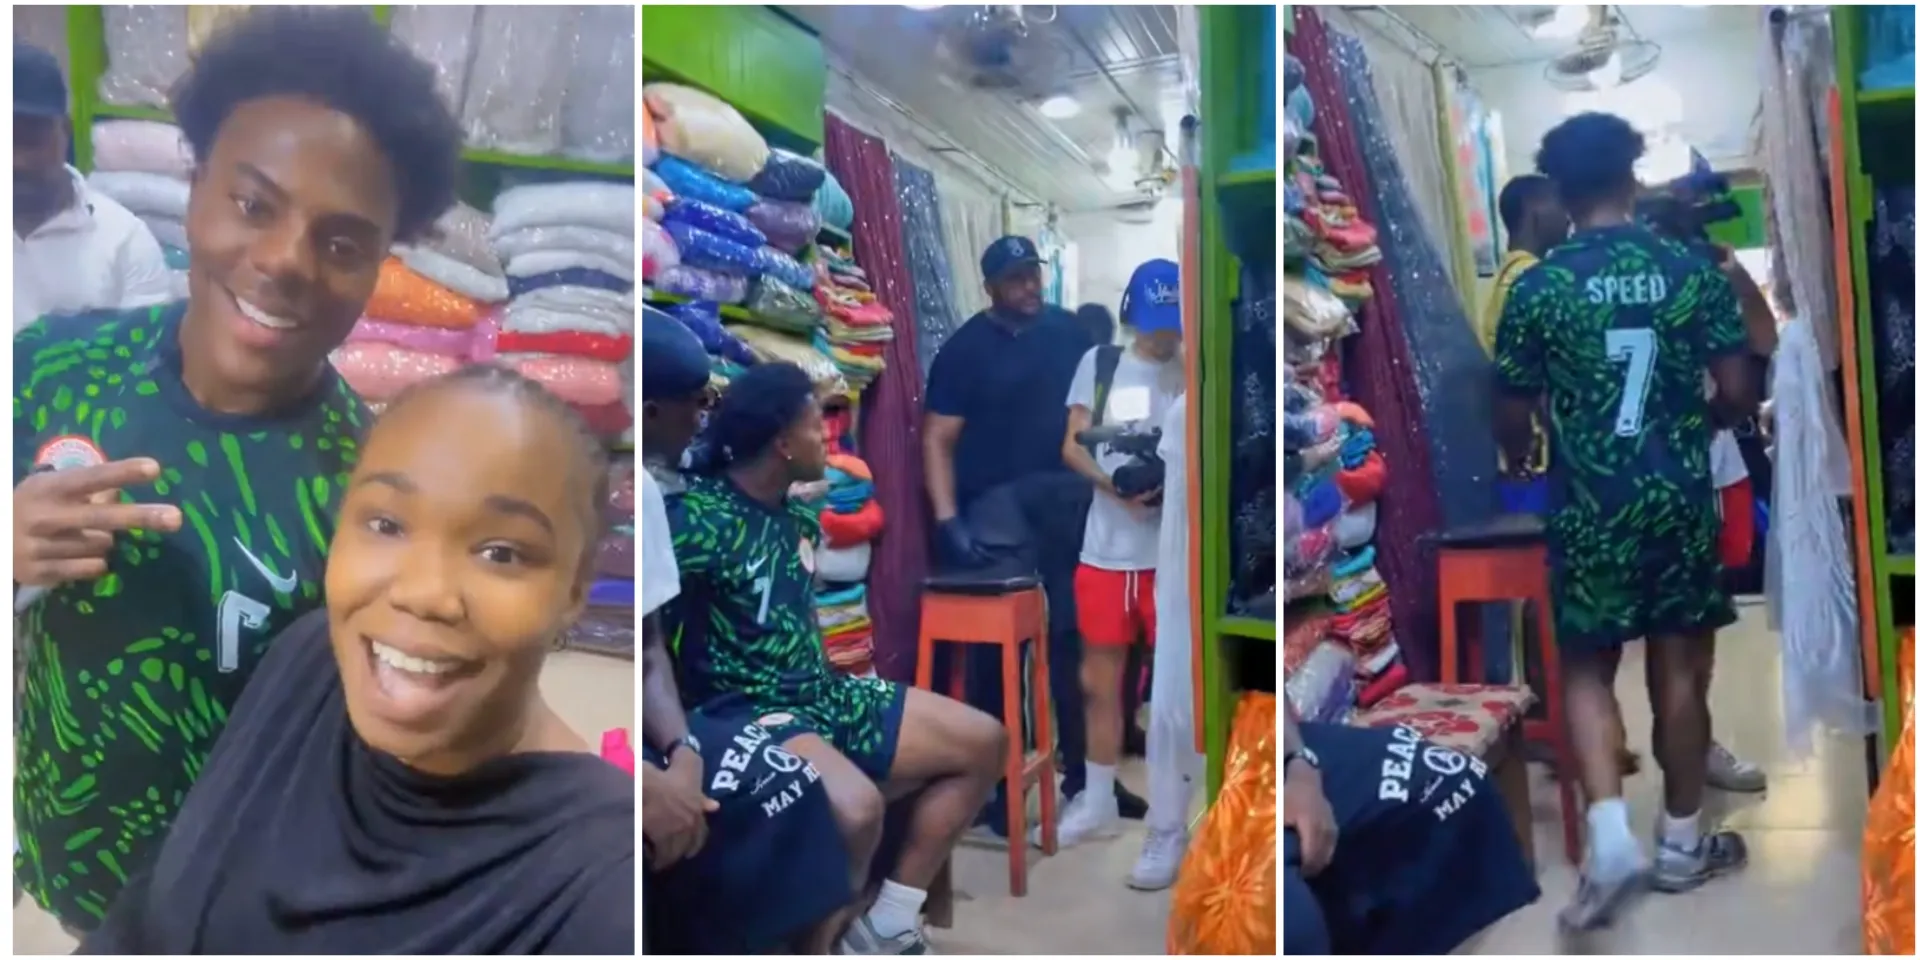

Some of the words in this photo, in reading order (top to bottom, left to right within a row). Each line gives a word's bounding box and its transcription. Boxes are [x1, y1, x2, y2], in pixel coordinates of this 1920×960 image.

[1585, 273, 1667, 304] SPEED
[1604, 327, 1659, 437] 7
[761, 779, 804, 818] MAY
[1433, 777, 1476, 821] MAY
